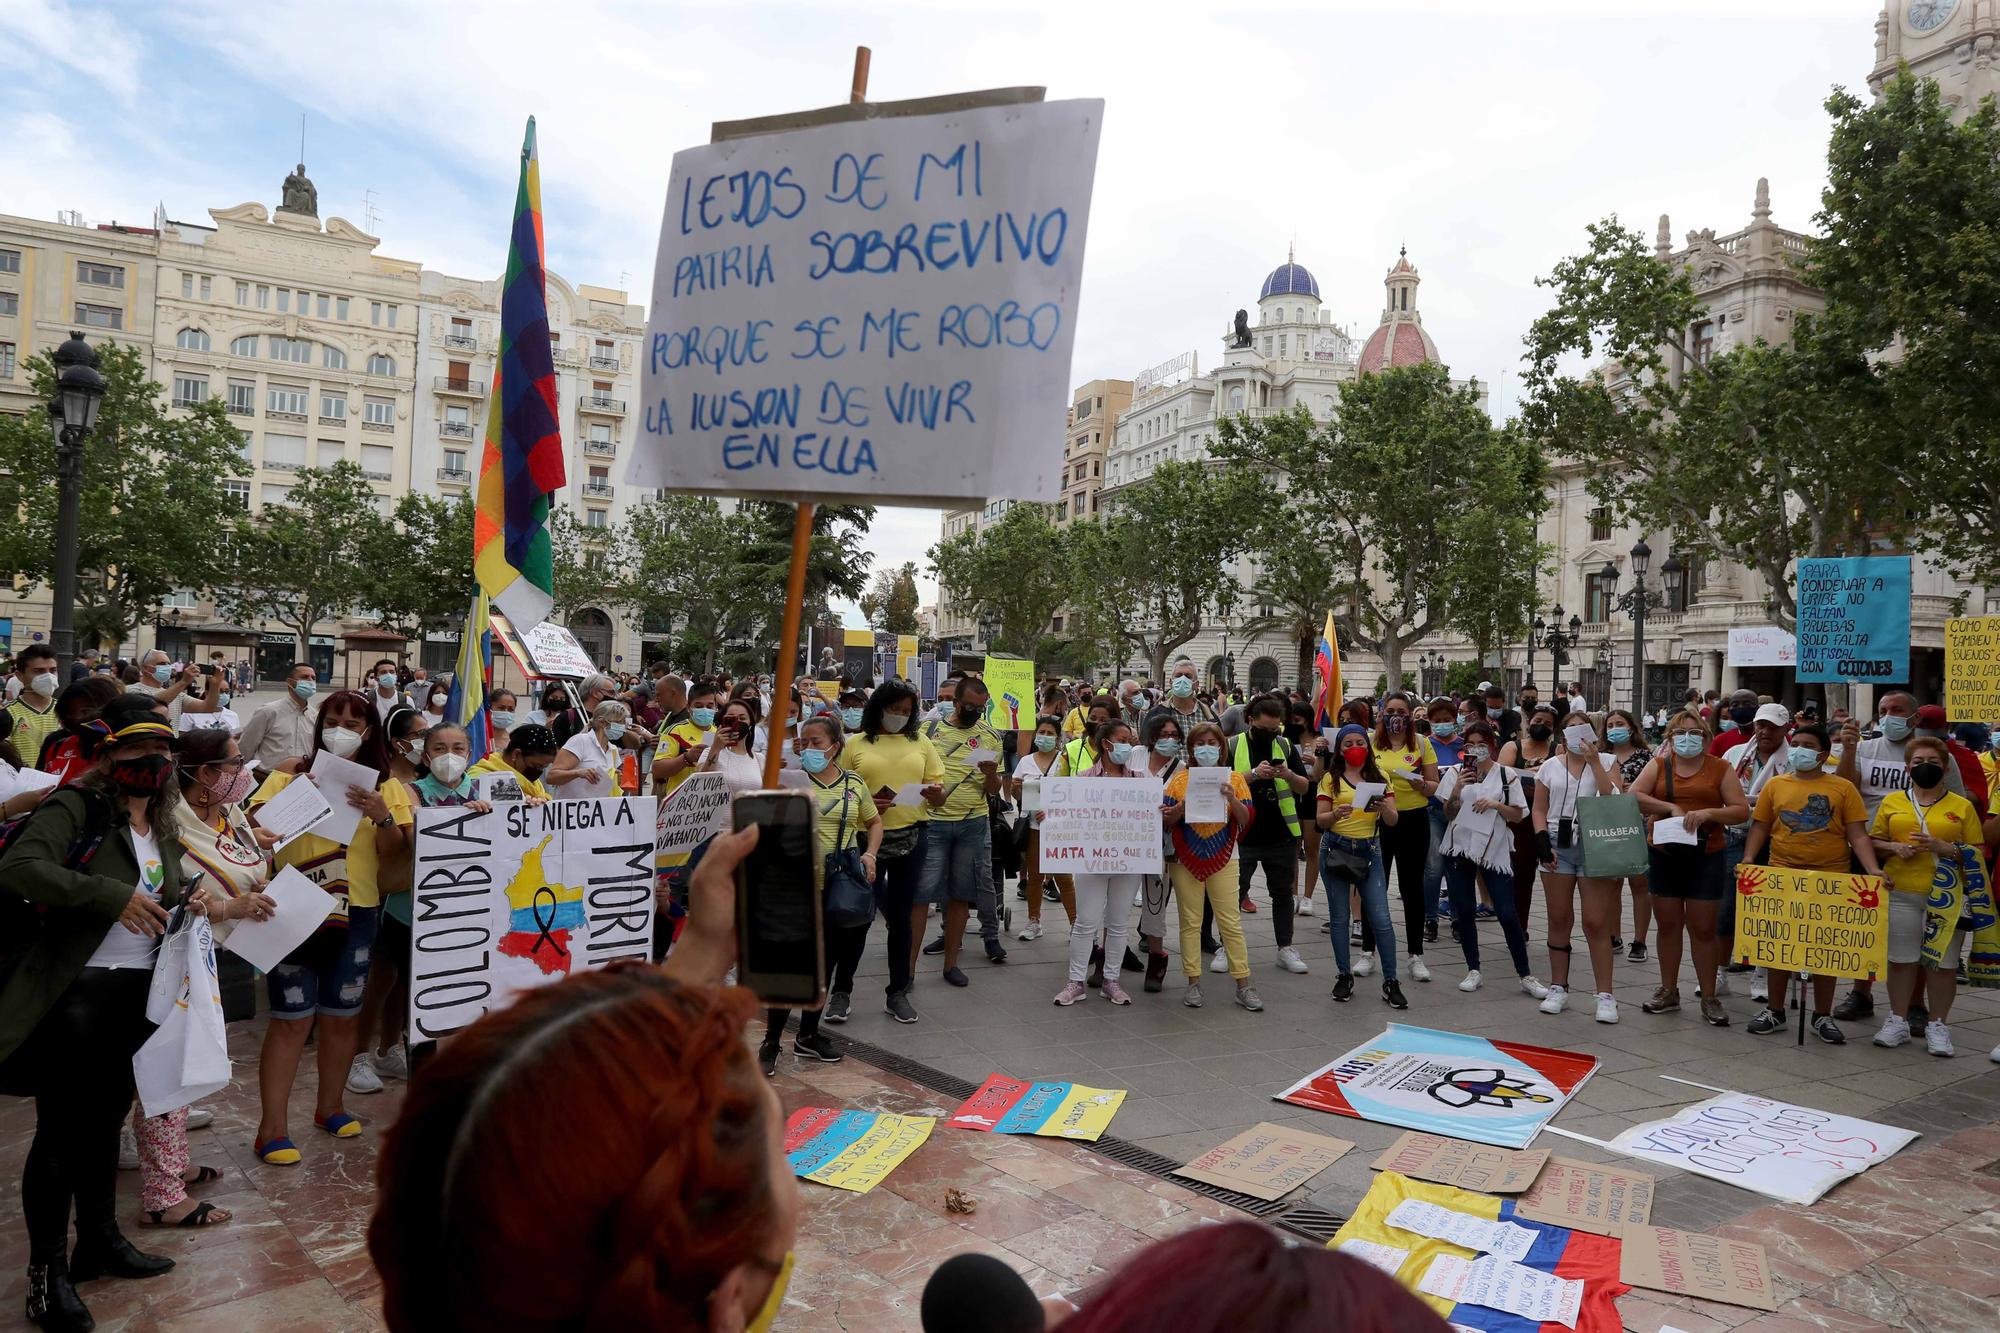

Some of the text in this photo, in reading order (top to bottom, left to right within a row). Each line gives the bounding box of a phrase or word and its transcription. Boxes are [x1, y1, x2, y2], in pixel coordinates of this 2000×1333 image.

[682, 140, 982, 235] LEJOS DE MI
[673, 207, 1067, 297] PATRIA SOBREVIVO
[651, 301, 1060, 374] PORQUE SE ME ROBO
[646, 398, 673, 435] LA
[691, 384, 800, 429] ILUSION
[817, 381, 870, 426] DE
[723, 433, 877, 475] EN ELLA
[1803, 563, 1841, 578] PARA
[1802, 578, 1884, 592] CONDENAR A
[1801, 593, 1865, 606] URIBE NO
[1803, 620, 1855, 633] PRUEBAS
[1950, 620, 1981, 632] COMO
[1801, 633, 1869, 646] SOLO FALTA
[1803, 647, 1855, 660] UN FISCAL
[1801, 660, 1893, 676] CON COJONES
[1951, 664, 1962, 676] ES
[1966, 664, 1979, 676] SU
[1950, 679, 1988, 691] CUANDO
[1954, 708, 1973, 720] UNA
[507, 798, 634, 838] SE NIEGA A
[685, 807, 715, 825] ESTAN
[1047, 808, 1108, 820] PROTESTA
[1111, 808, 1124, 818] EN
[656, 826, 707, 849] MATANDO
[1589, 826, 1640, 838] PULL&BEAR
[1045, 846, 1157, 859] MATA MAS QUE EL
[1768, 874, 1842, 896] SE VE QUE
[1743, 895, 1878, 926] MATAR NO ES PECADO
[1743, 916, 1875, 949] CUANDO EL ASESINO
[1757, 940, 1861, 972] ES EL ESTADO
[1325, 1050, 1392, 1084] PRESENTE
[1192, 1146, 1236, 1171] GUERRA
